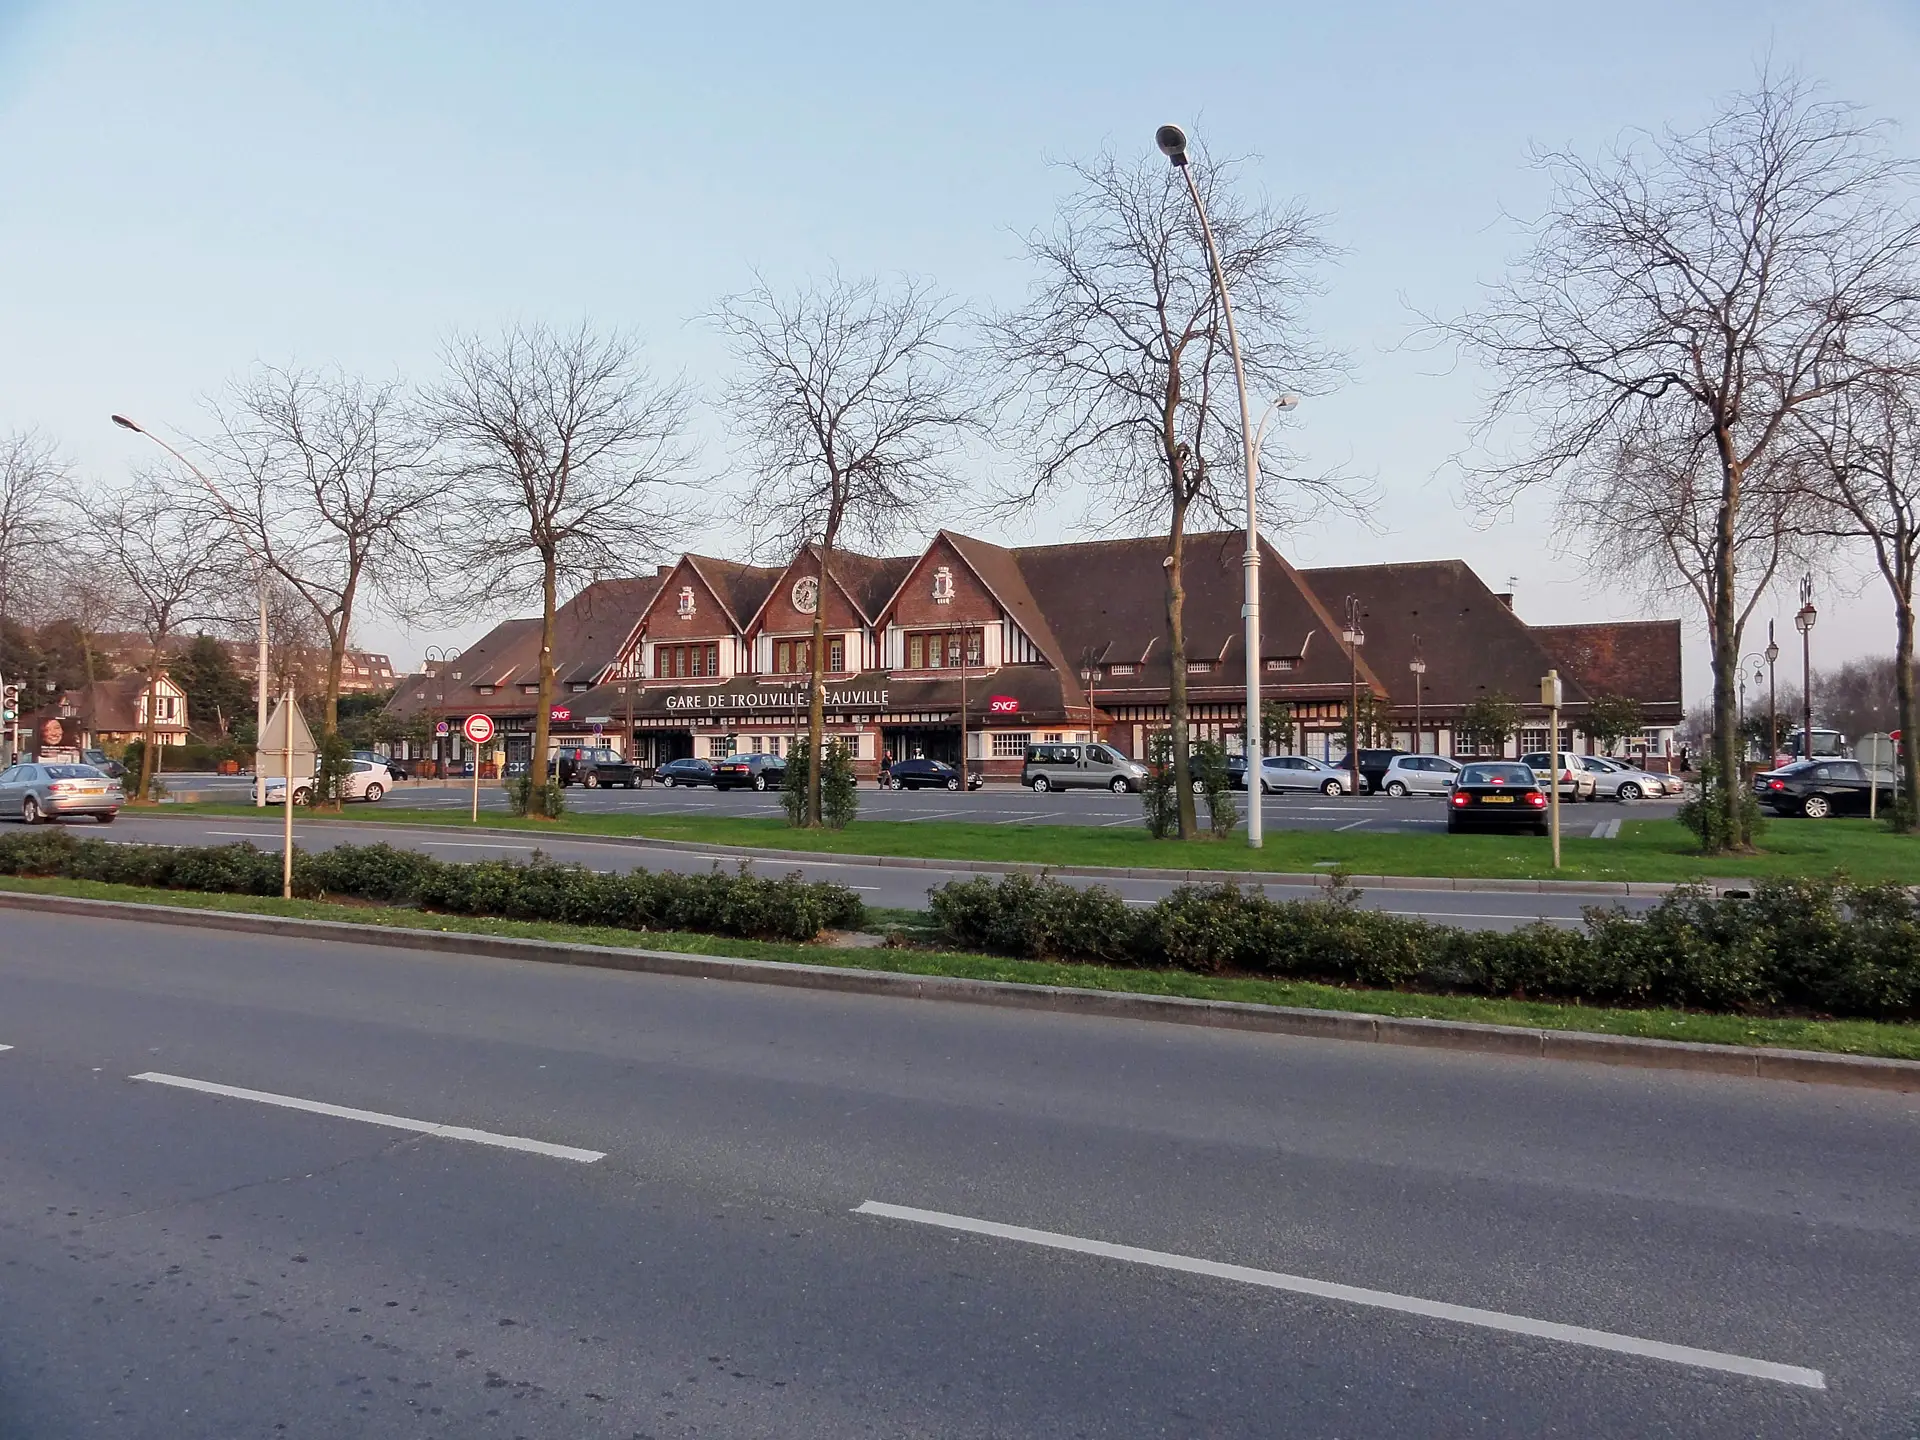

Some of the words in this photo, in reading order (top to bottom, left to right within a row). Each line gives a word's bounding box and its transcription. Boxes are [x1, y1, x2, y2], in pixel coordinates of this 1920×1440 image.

[666, 695, 701, 708] GARE
[708, 694, 725, 707] DE
[730, 690, 889, 707] TROUVILLE-EAUVILLE
[991, 701, 1018, 711] SNCF
[551, 710, 571, 719] SNCF
